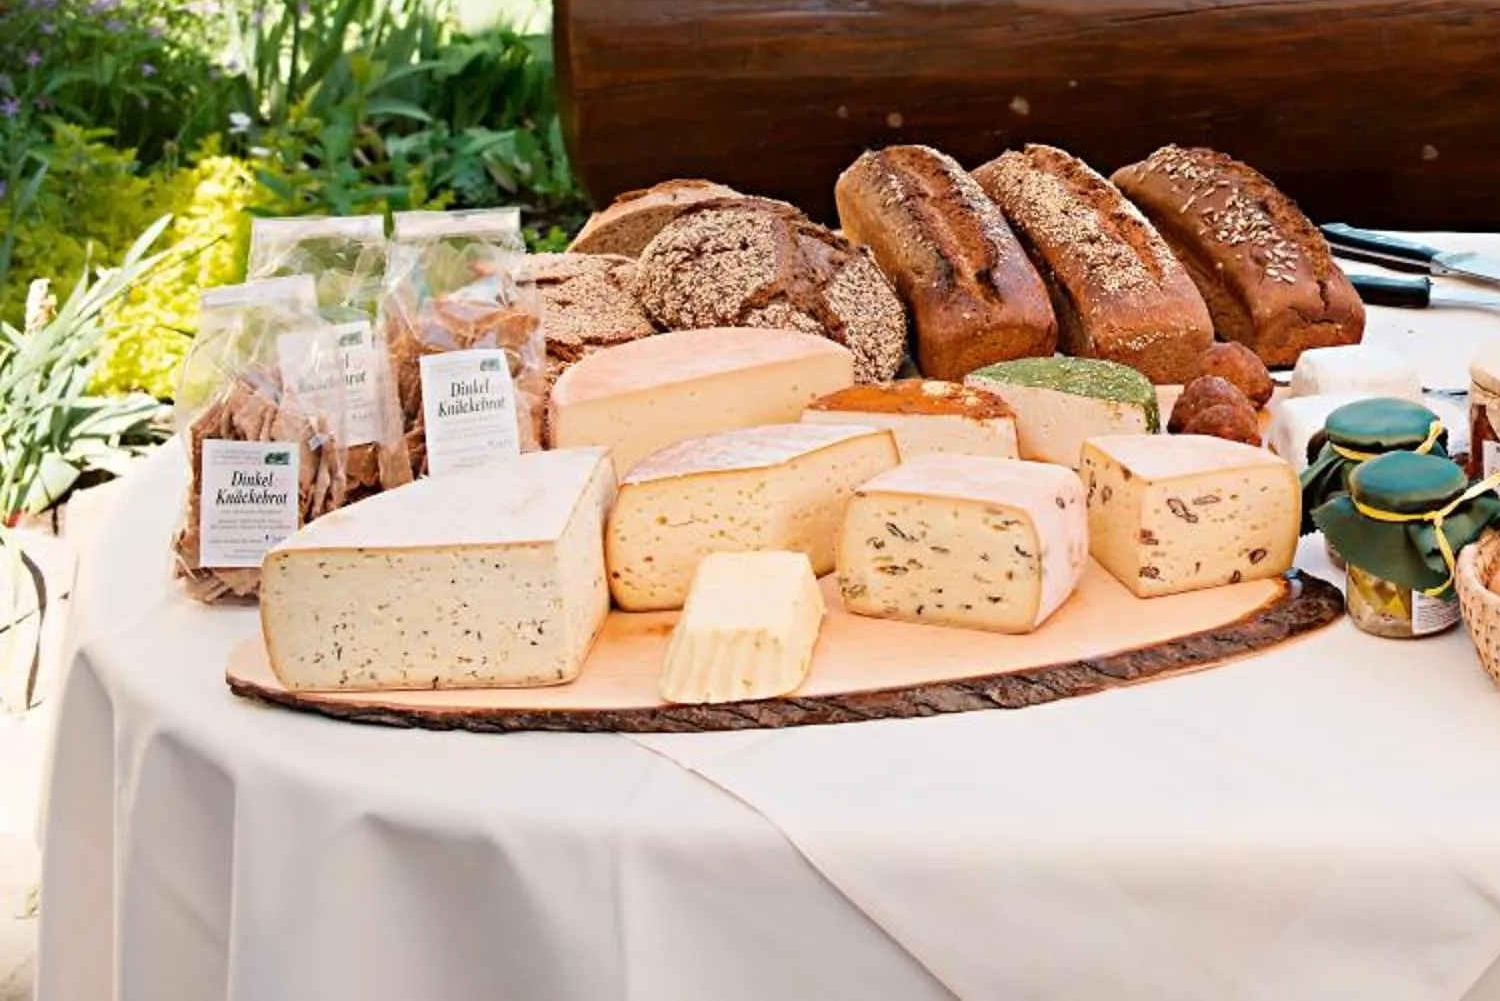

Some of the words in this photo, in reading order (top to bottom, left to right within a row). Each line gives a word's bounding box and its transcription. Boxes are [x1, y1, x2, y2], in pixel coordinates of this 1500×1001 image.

[450, 378, 490, 398] Dinkel
[437, 396, 504, 417] Knäckebrot
[231, 470, 274, 487] Dinkel
[215, 488, 288, 505] Knäckebrot
